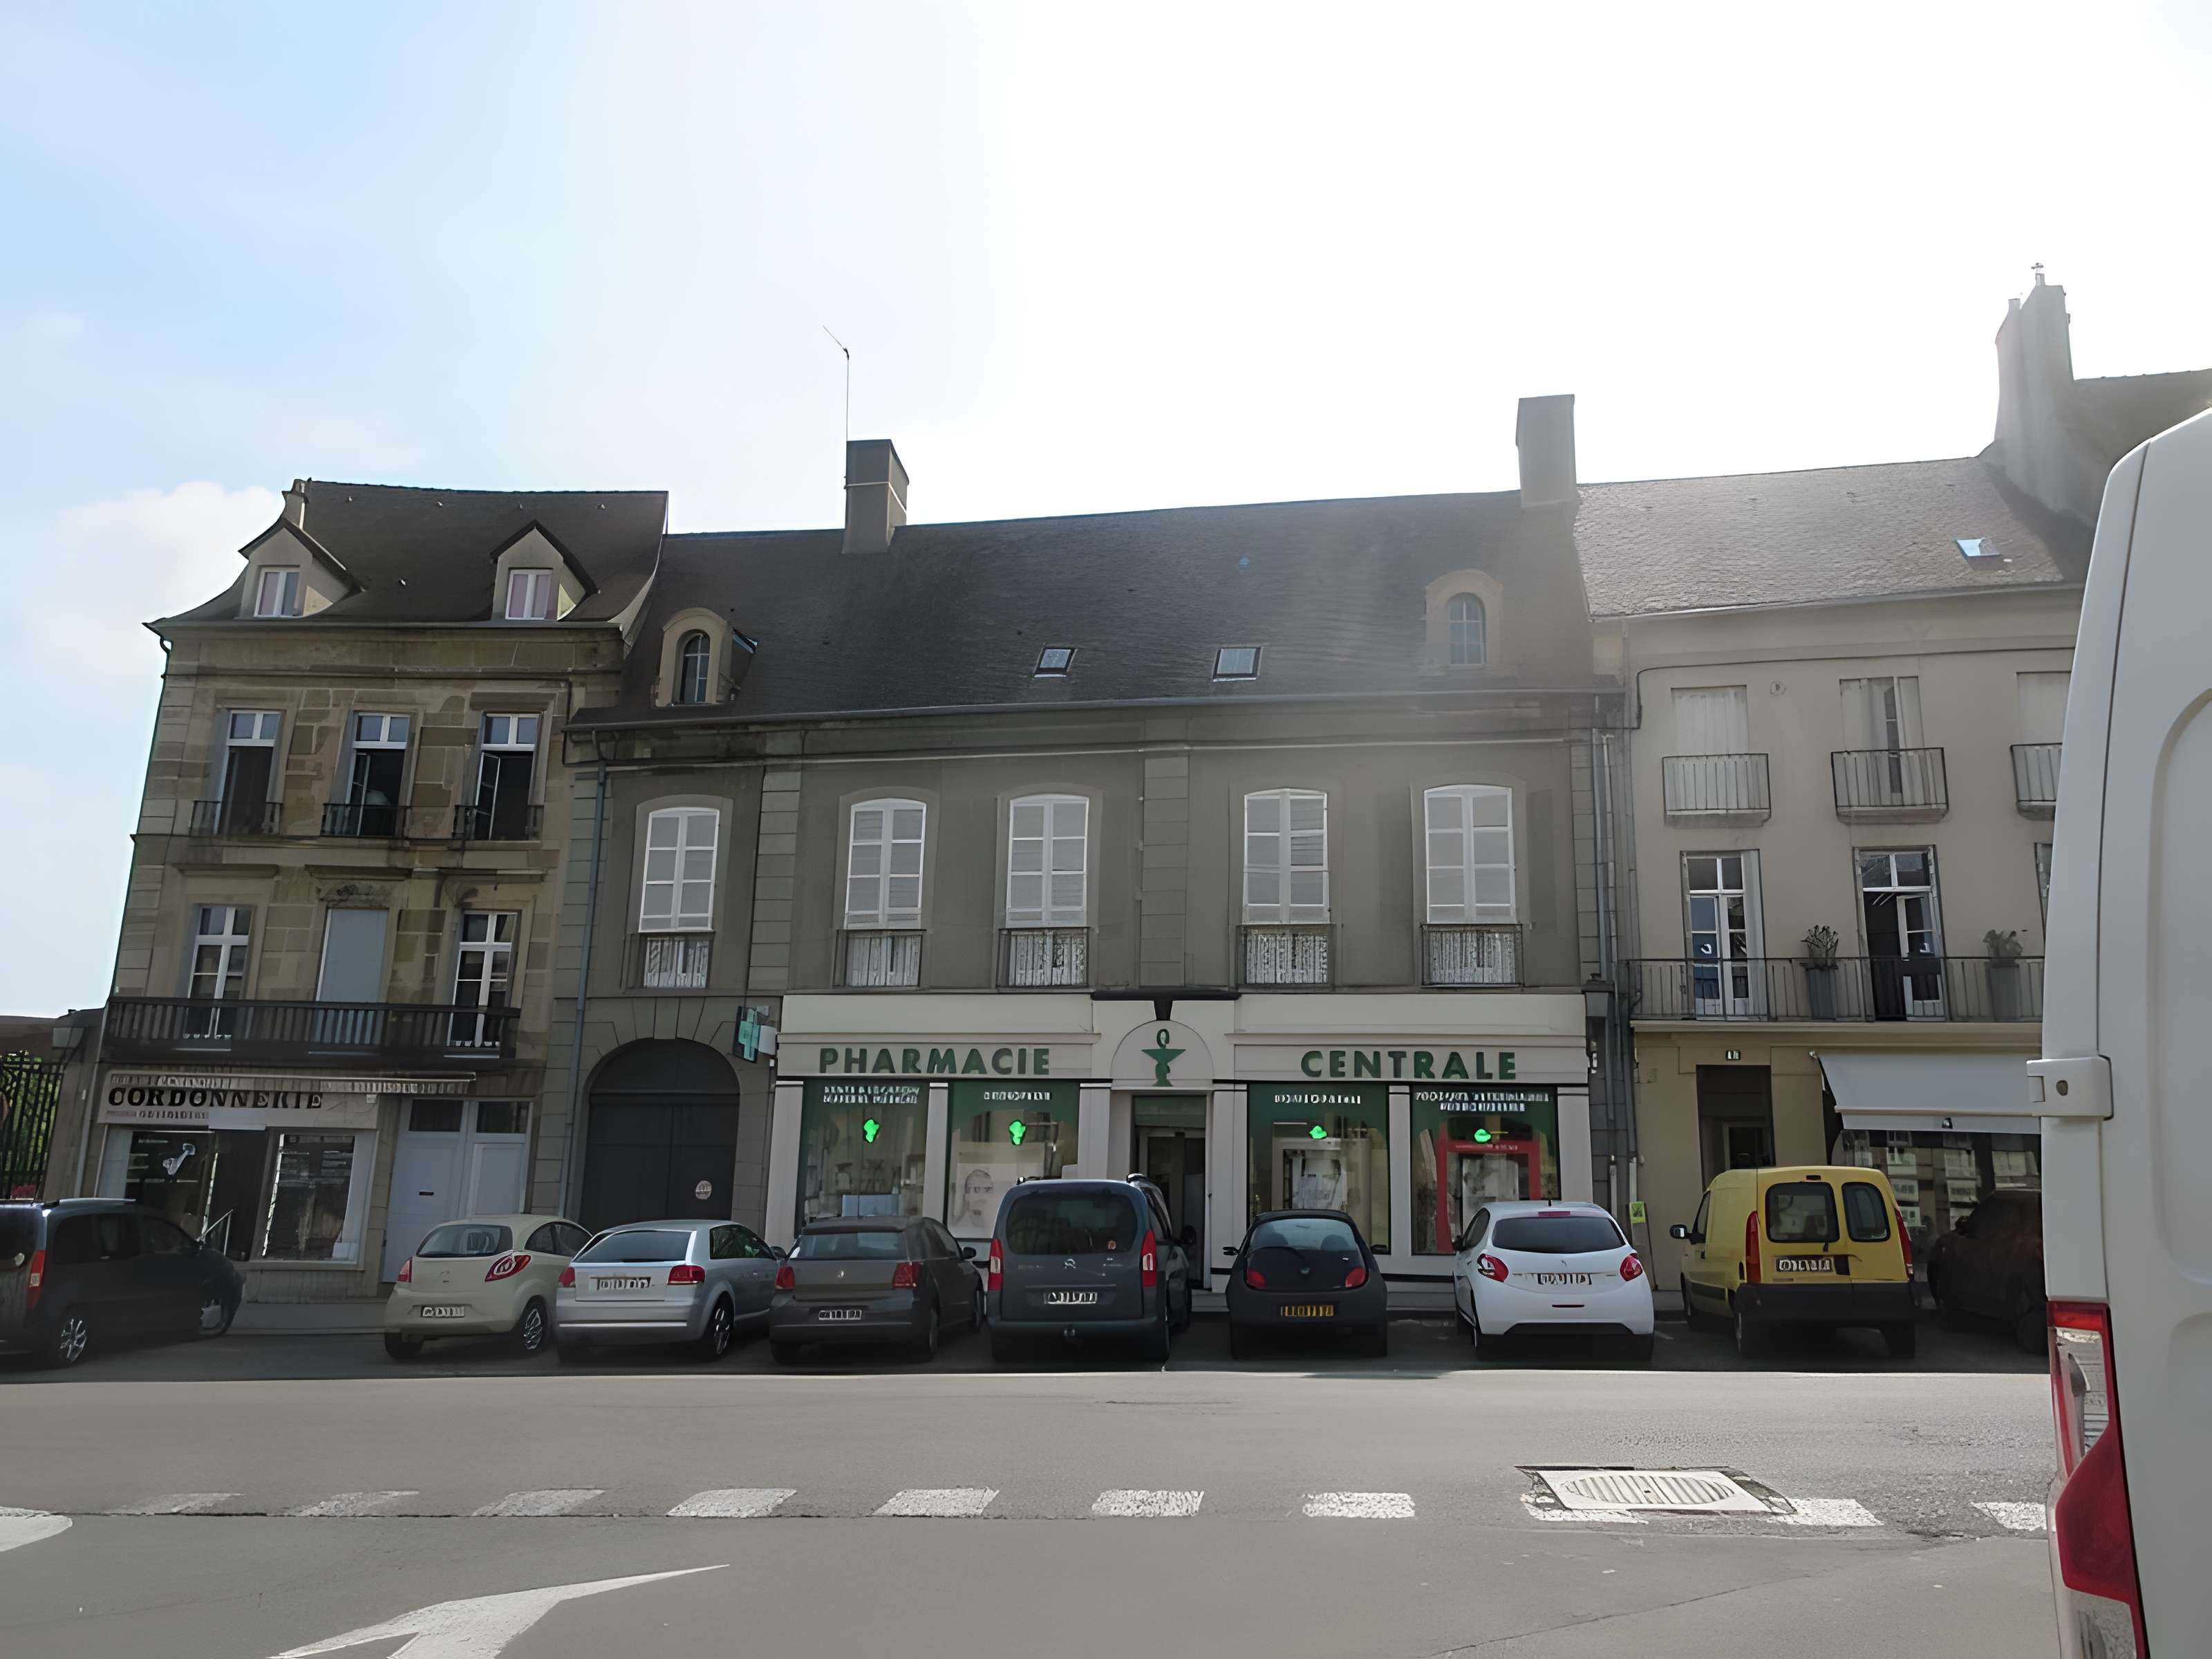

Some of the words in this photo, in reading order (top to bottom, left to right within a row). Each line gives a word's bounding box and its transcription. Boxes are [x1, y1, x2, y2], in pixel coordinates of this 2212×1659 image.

[819, 1047, 1049, 1075] PHARMACIE
[1300, 1050, 1517, 1080] CENTRALE
[108, 1087, 323, 1109] CORDONNERIE
